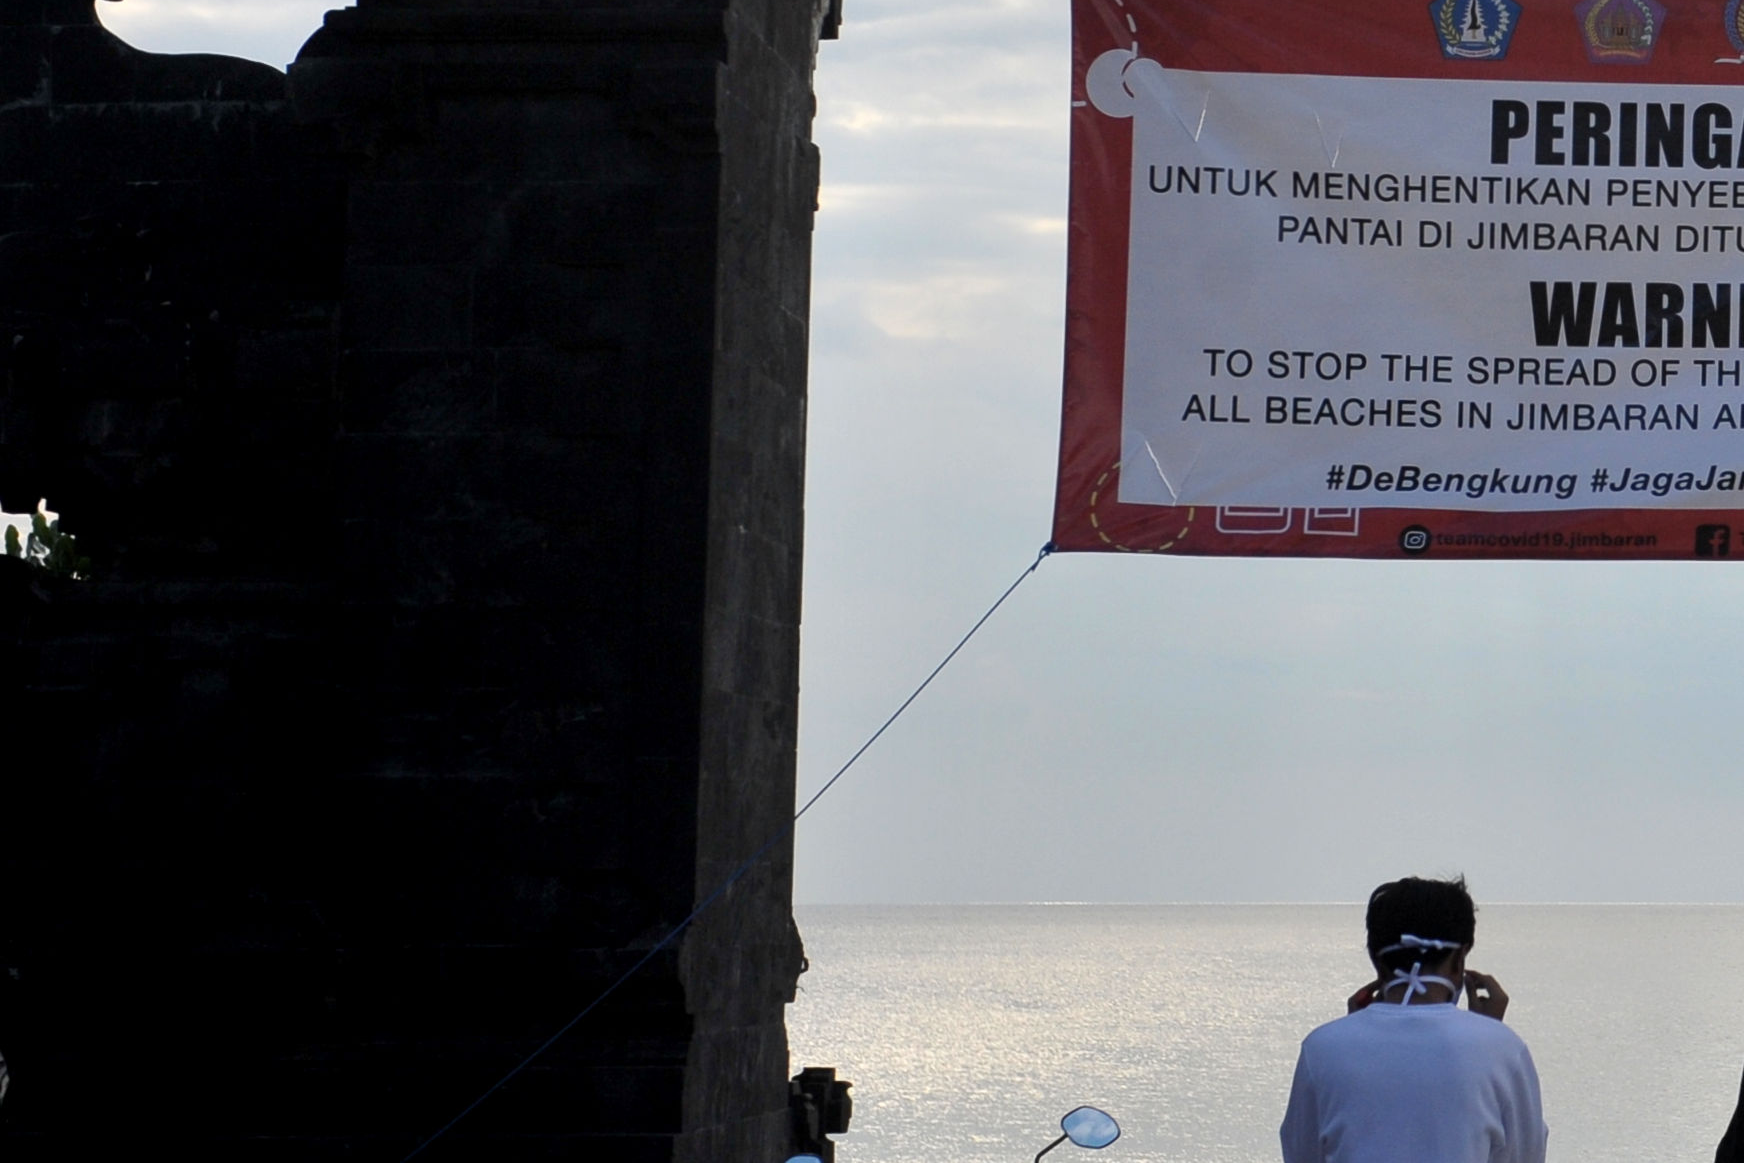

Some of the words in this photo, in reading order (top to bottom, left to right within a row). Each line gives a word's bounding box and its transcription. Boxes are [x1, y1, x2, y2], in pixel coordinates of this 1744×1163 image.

[1149, 164, 1278, 198] UNTUK
[1292, 170, 1590, 206] MENGHENTIKAN
[1278, 215, 1402, 247] PANTAI
[1419, 220, 1452, 249] DI
[1467, 221, 1659, 252] JIMBARAN
[1202, 348, 1253, 378] TO
[1267, 350, 1367, 381] STOP
[1380, 354, 1453, 383] THE
[1466, 356, 1617, 387] SPREAD
[1630, 358, 1681, 388] OF
[1181, 394, 1251, 423] ALL
[1265, 395, 1442, 428] BEACHES
[1457, 401, 1492, 430] IN
[1506, 403, 1699, 431] JIMBARAN
[1325, 464, 1578, 500] #DeBengkung
[1436, 532, 1657, 550] teamcovid19.jimbaran
